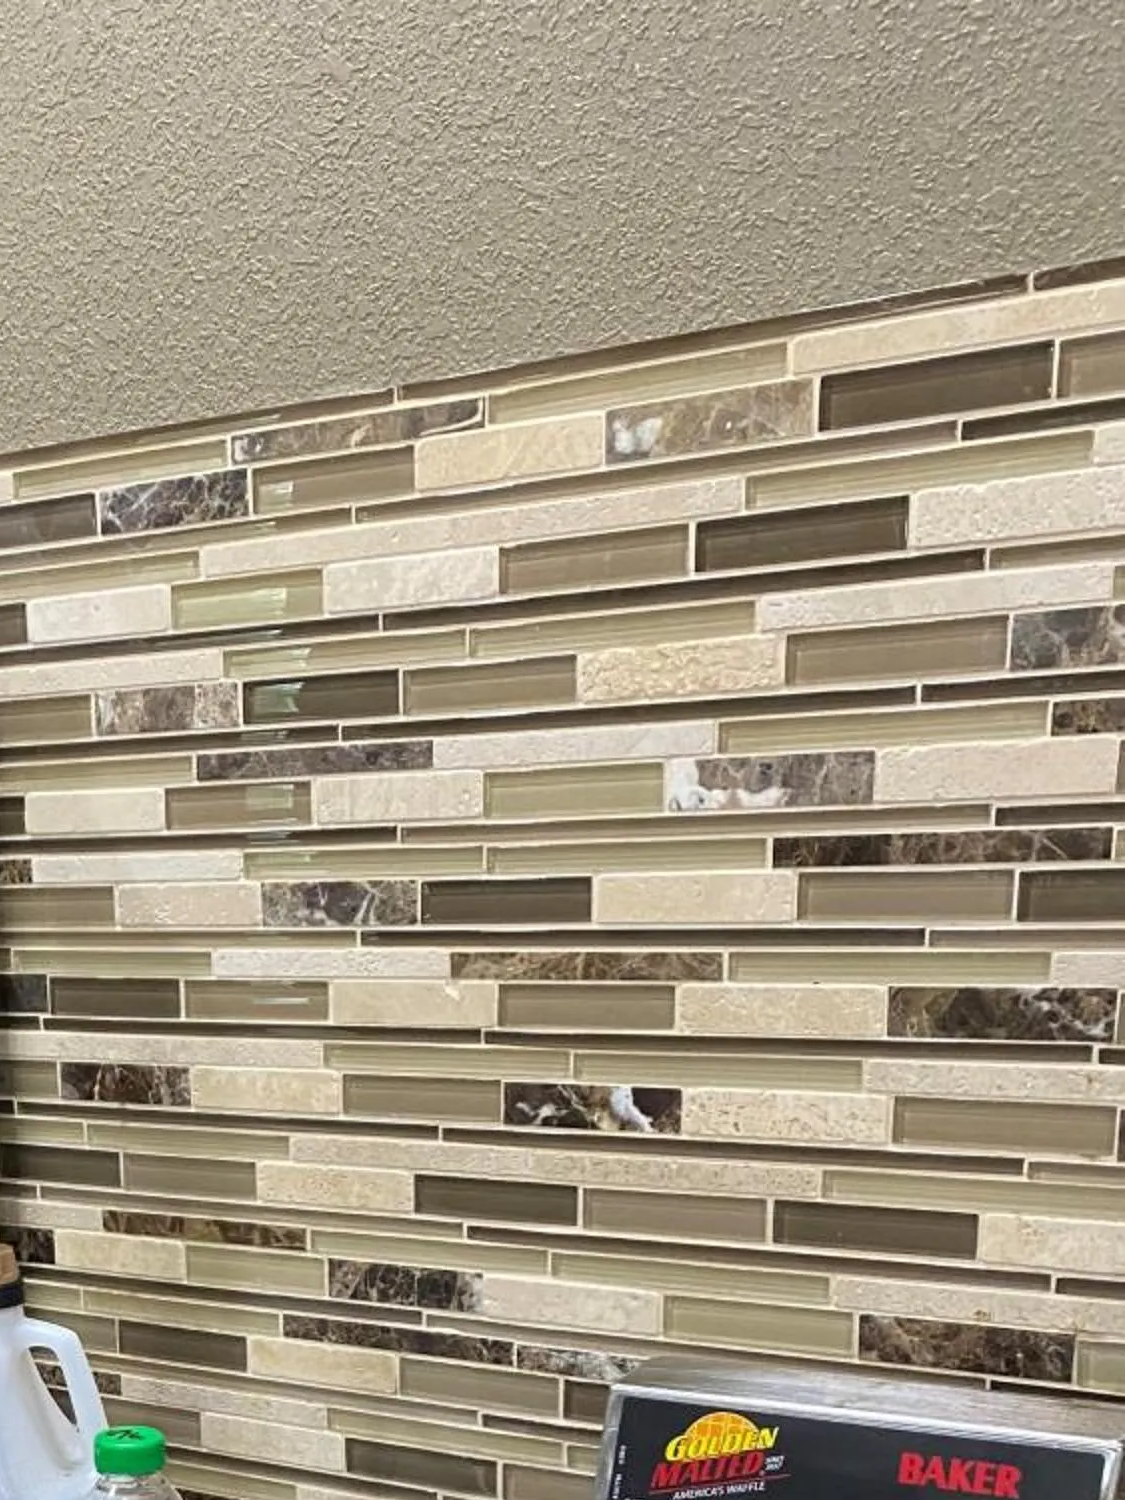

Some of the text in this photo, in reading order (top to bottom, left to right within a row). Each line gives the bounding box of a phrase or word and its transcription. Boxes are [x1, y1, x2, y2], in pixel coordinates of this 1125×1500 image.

[665, 1426, 780, 1462] GOLDEN
[650, 1451, 764, 1489] MALTED
[896, 1451, 1025, 1499] BAKER
[672, 1480, 766, 1500] AMERICA'S WAFFLE
